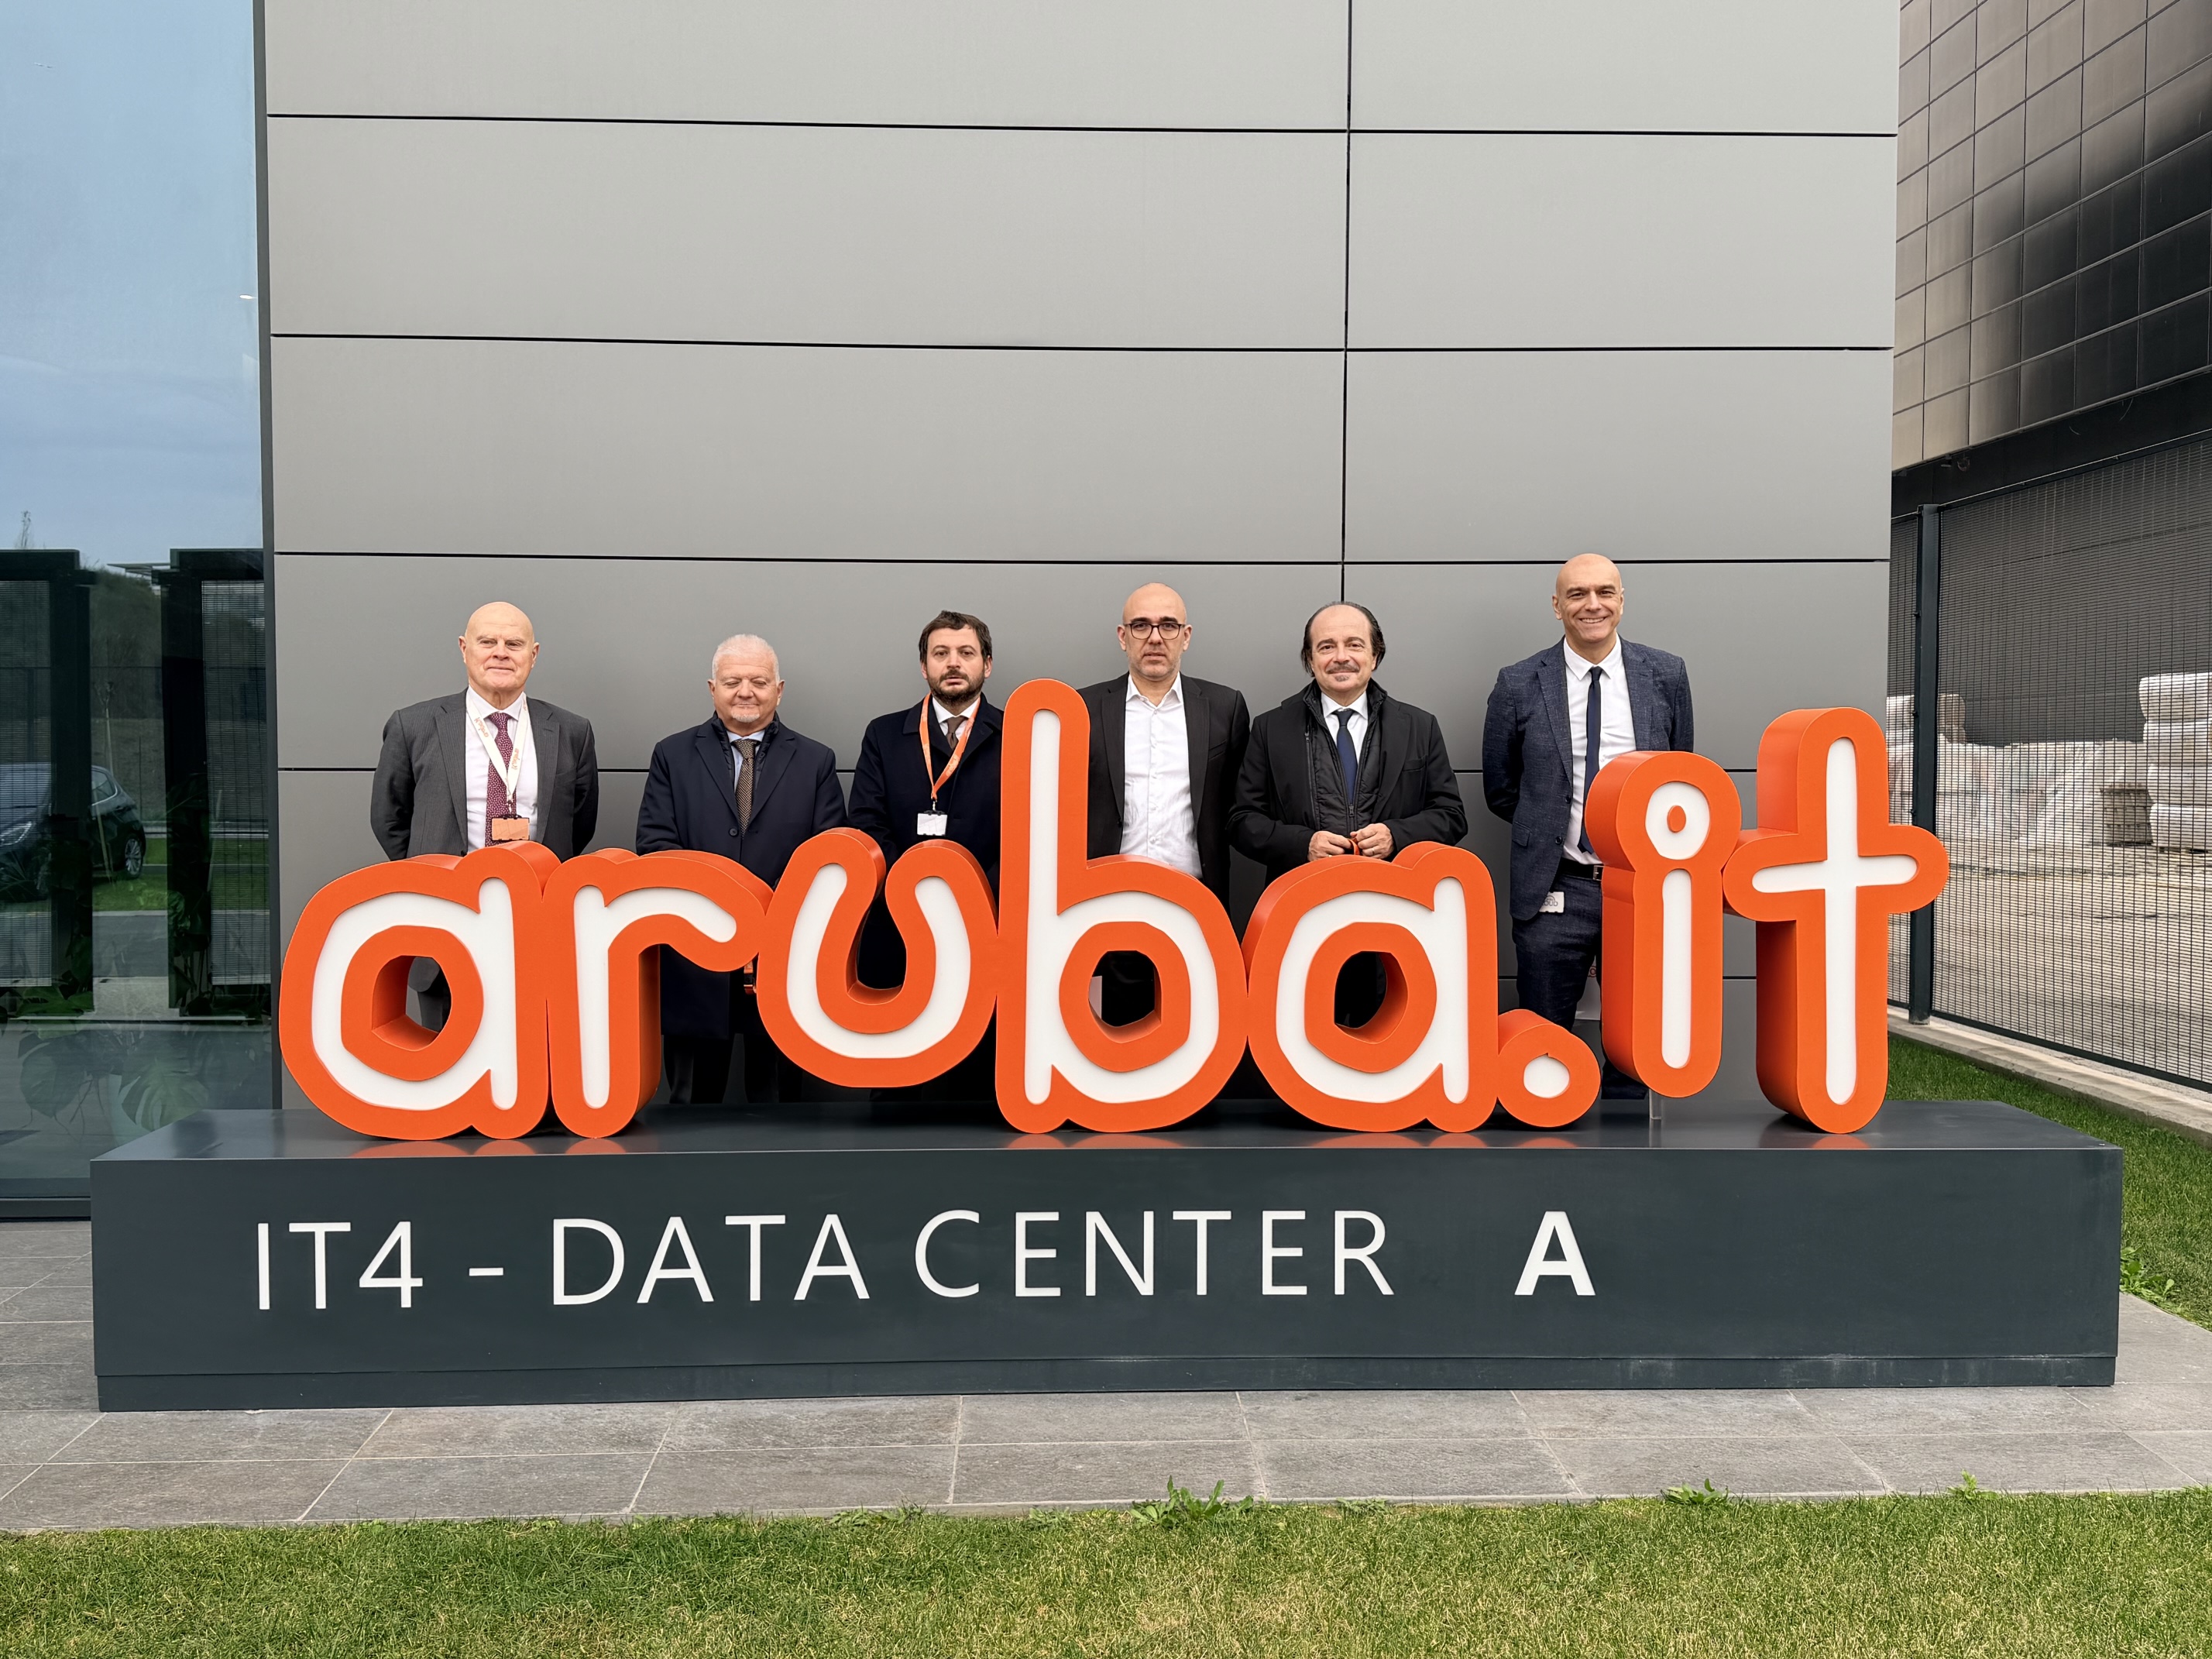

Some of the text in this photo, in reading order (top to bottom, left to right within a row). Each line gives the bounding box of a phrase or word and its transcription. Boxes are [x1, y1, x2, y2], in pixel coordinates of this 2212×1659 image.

[280, 680, 1950, 1135] aruba.it
[257, 1209, 1596, 1310] IT4 - DATA CENTER A
